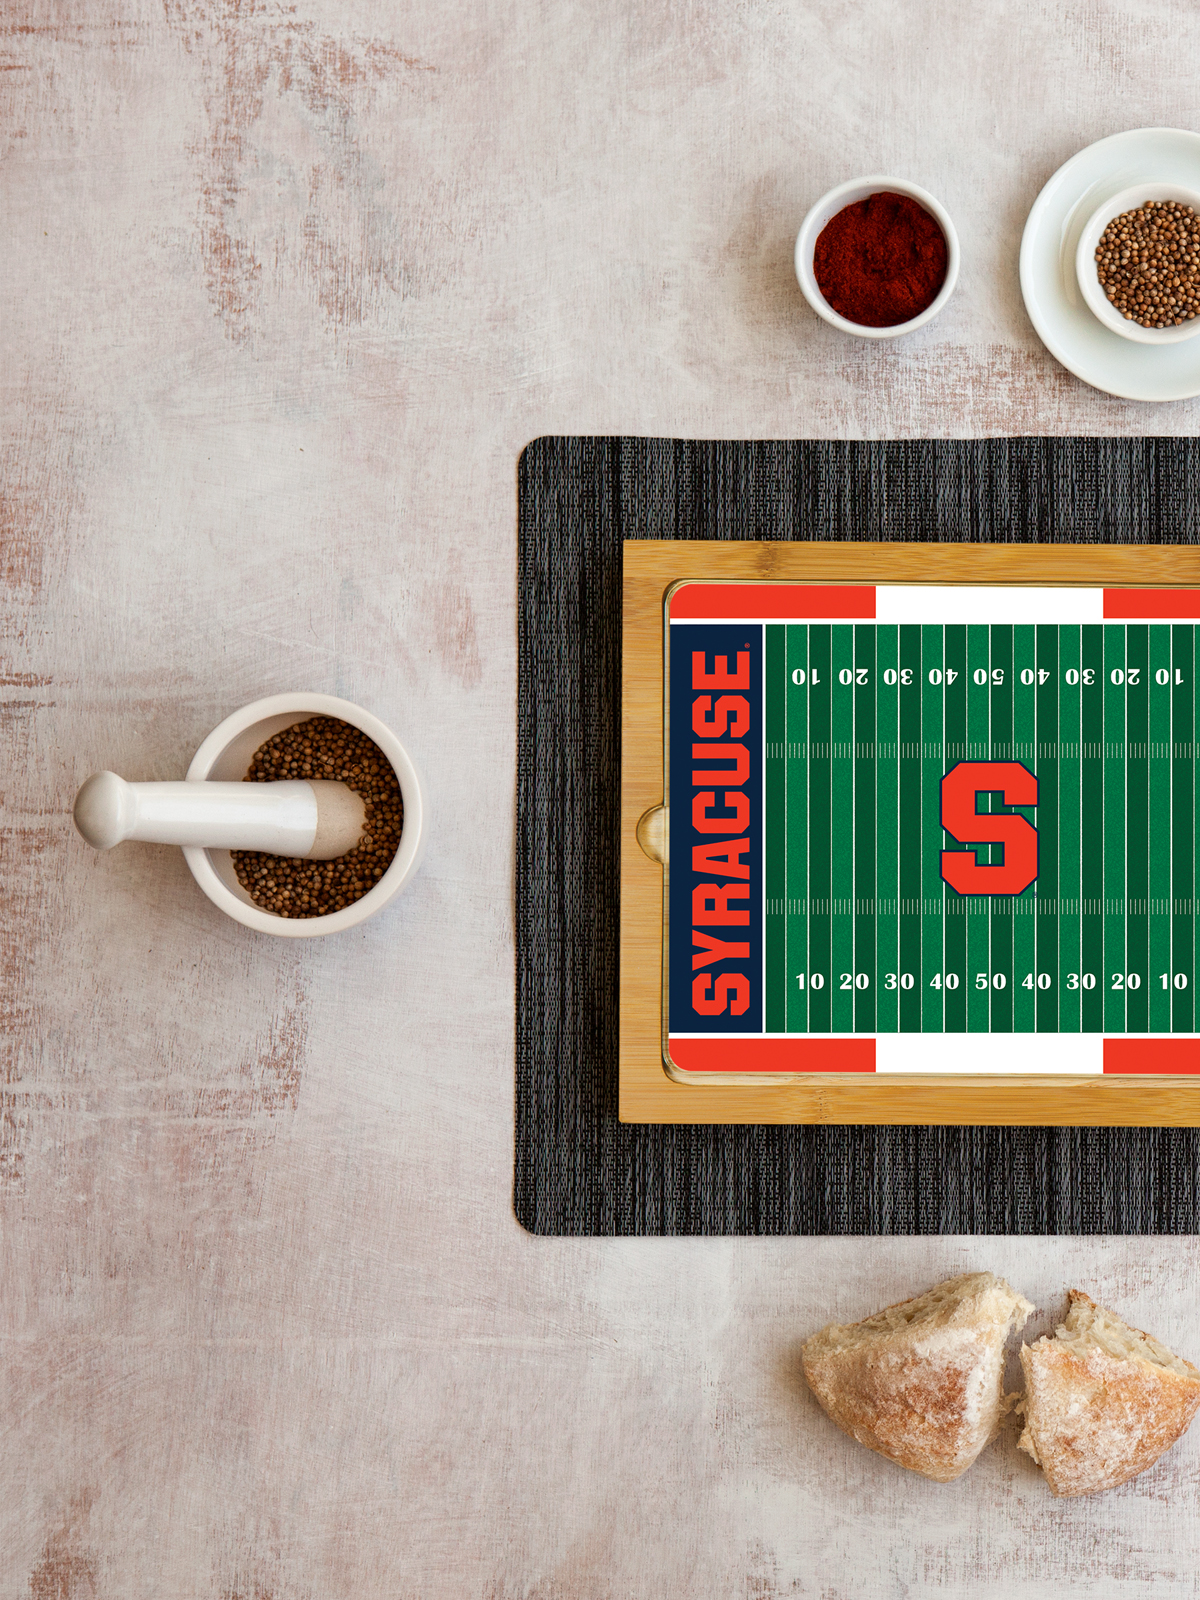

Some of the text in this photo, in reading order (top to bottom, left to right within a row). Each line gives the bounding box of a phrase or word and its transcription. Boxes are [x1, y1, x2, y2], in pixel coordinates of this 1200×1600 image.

[791, 668, 1185, 686] 10 20 30 40 50 40 30 20 10
[692, 651, 750, 1016] SYRACUSE
[939, 760, 1040, 897] S
[795, 973, 1189, 990] 10 20 30 40 50 40 30 20 10
